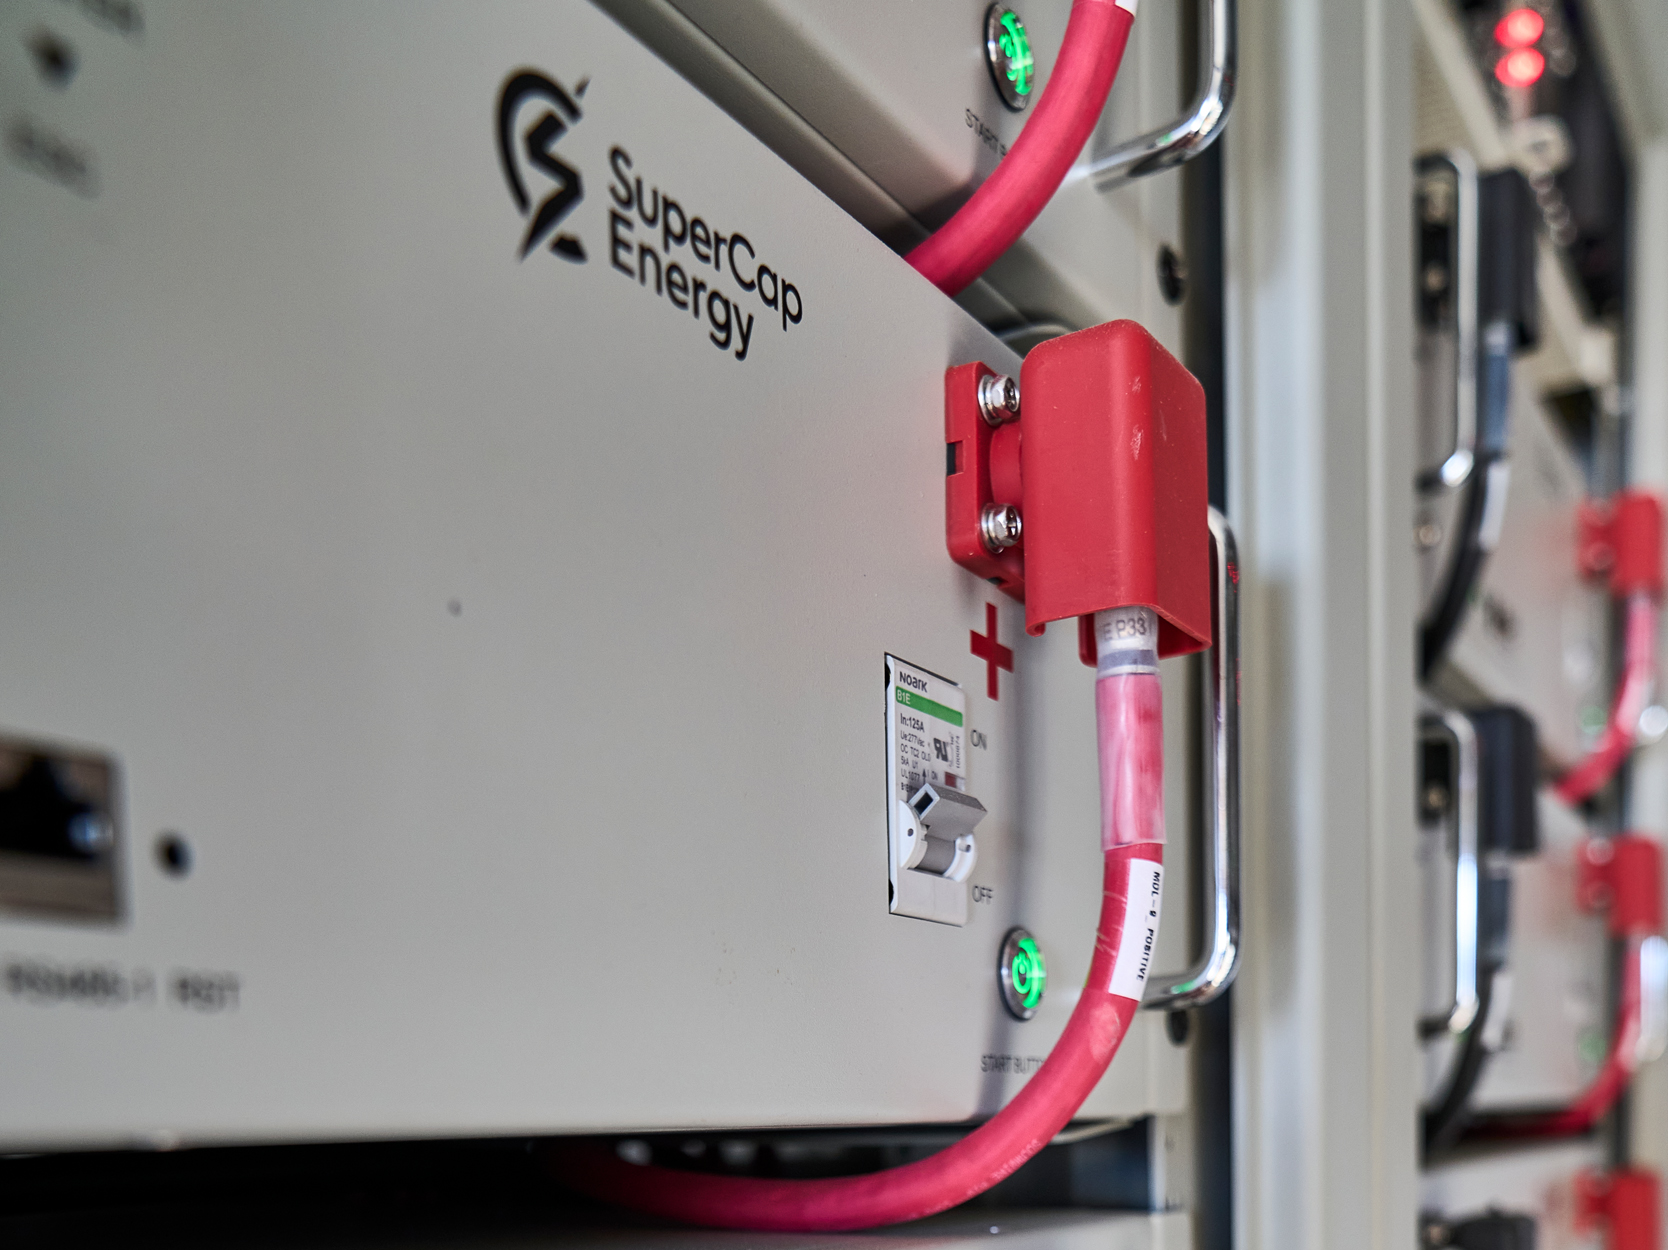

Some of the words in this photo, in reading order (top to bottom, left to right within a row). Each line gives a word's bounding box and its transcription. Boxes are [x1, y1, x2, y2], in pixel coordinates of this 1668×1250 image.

[609, 144, 803, 333] SuperCap
[609, 206, 754, 362] Energy
[896, 690, 911, 705] B1E
[900, 713, 925, 733] In:125A
[970, 729, 987, 751] ON
[972, 885, 993, 905] OFF
[1137, 928, 1155, 982] POSITIVE
[981, 1053, 1012, 1073] START
